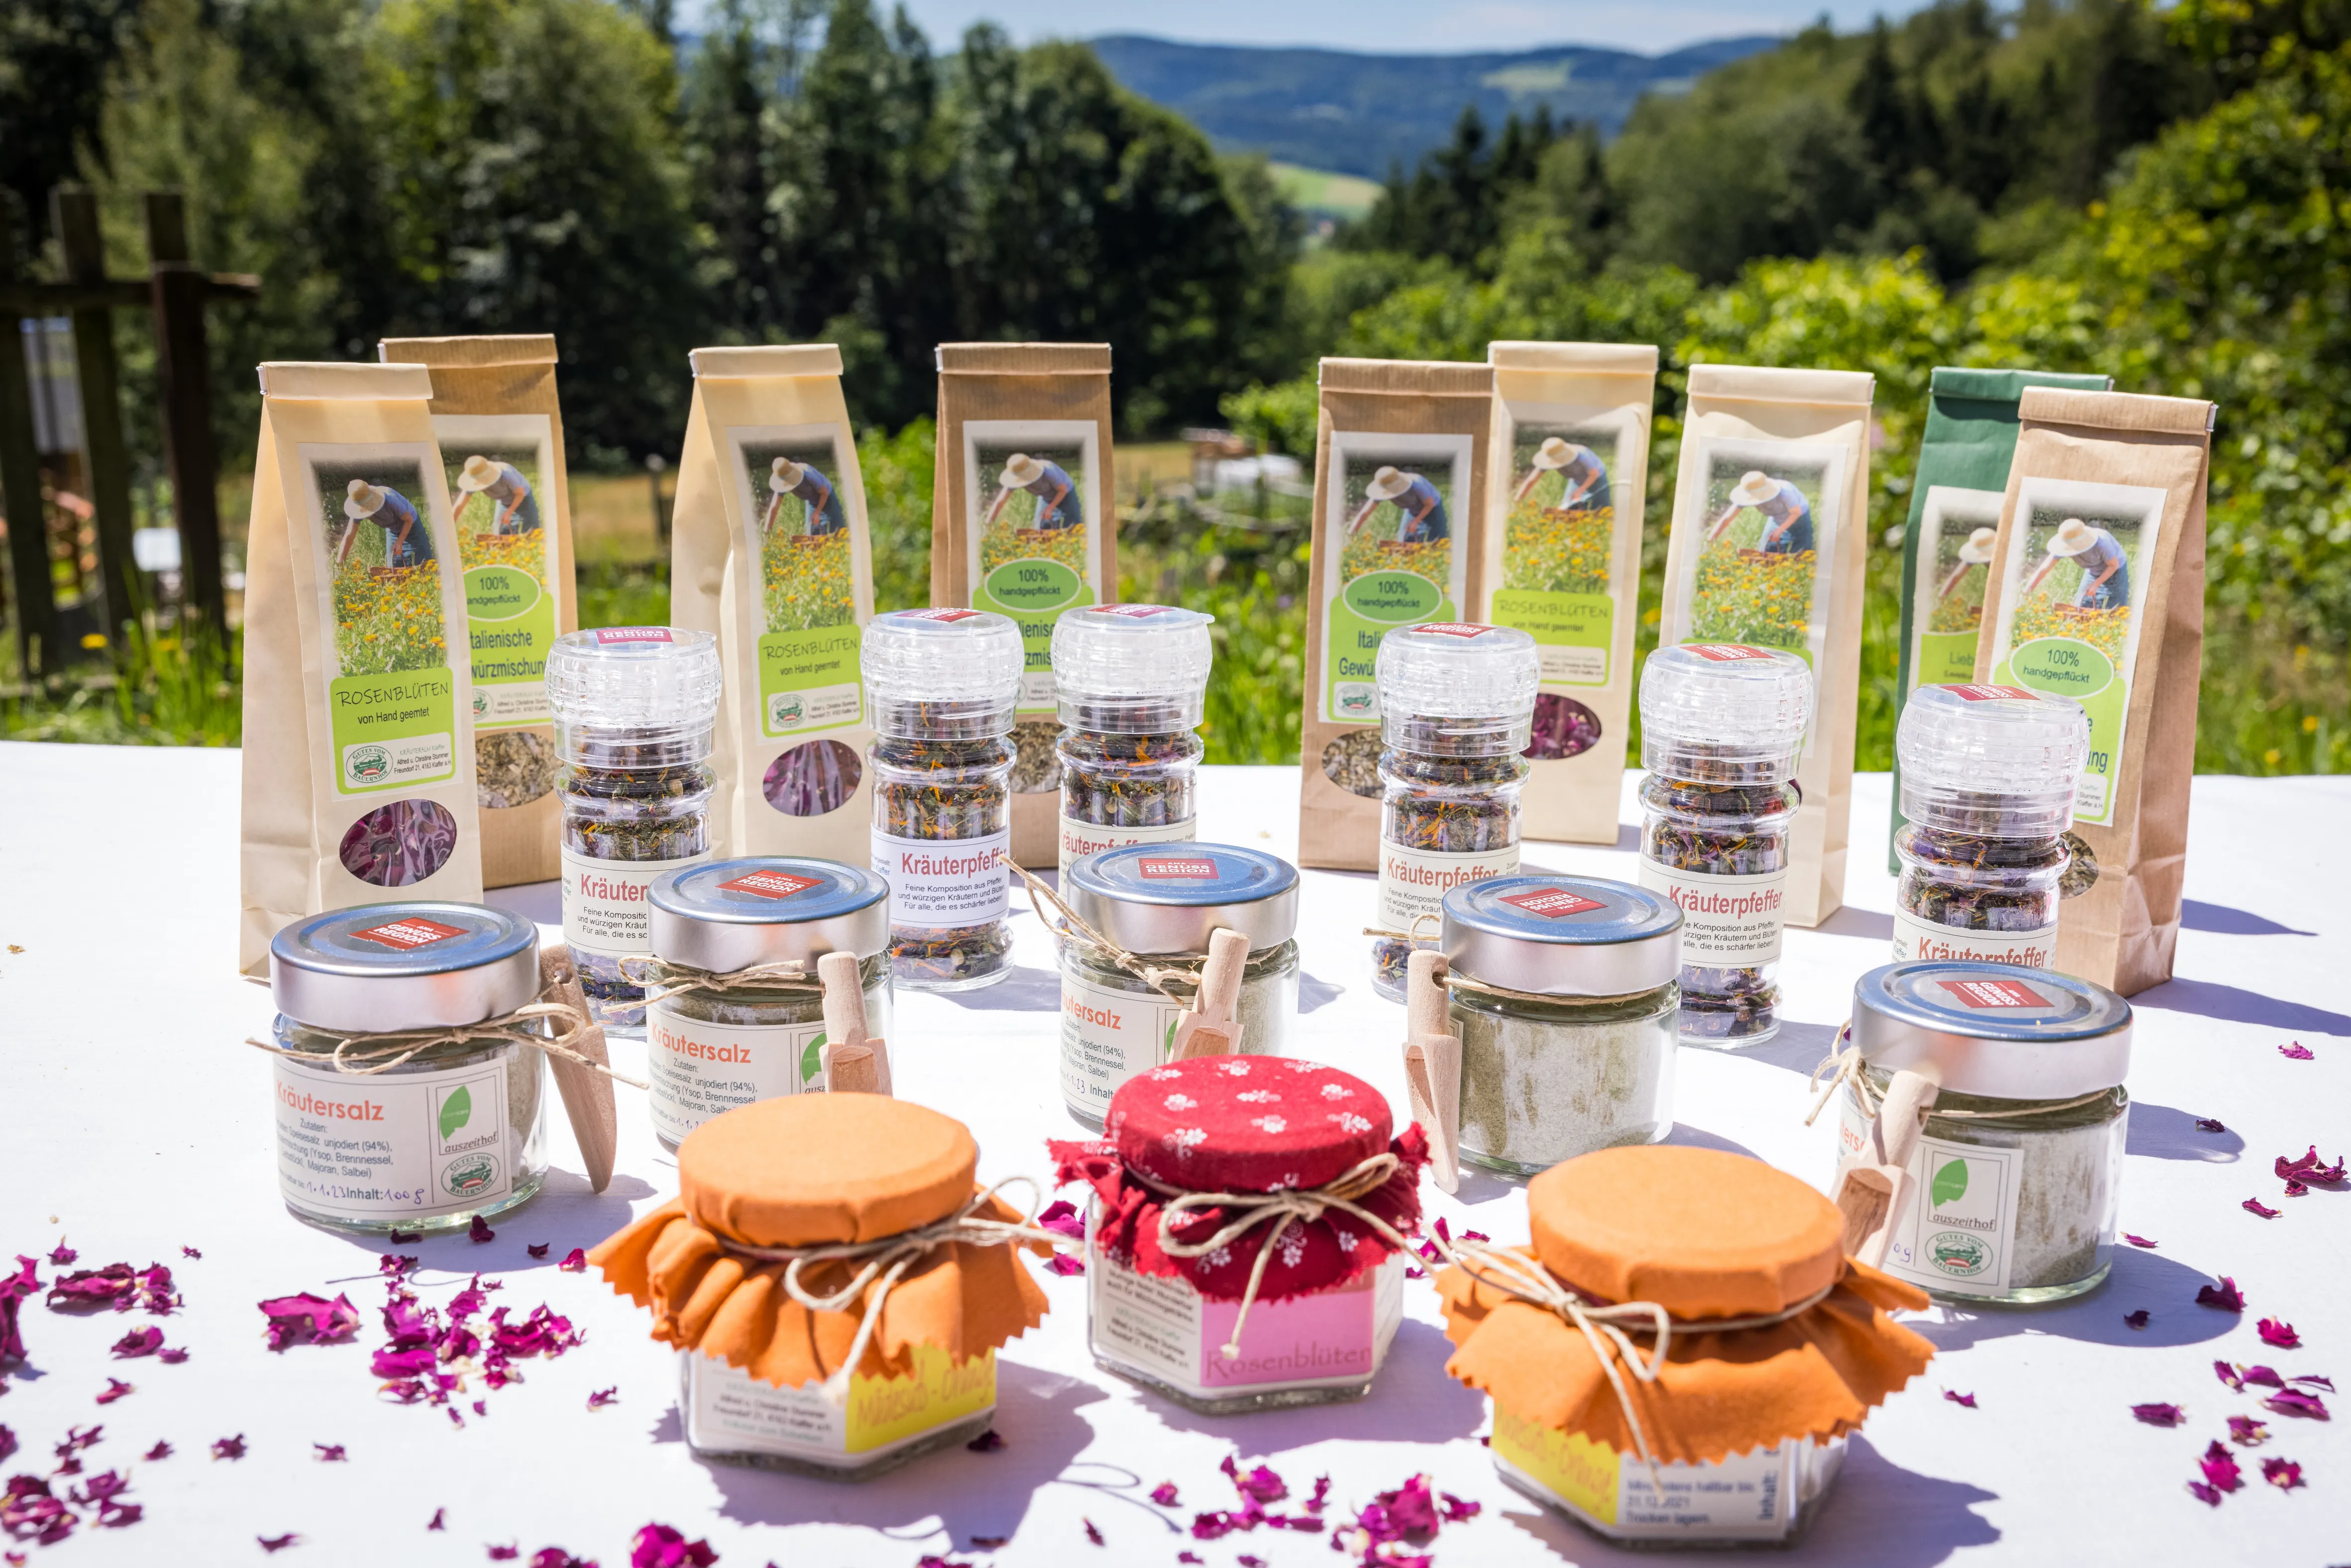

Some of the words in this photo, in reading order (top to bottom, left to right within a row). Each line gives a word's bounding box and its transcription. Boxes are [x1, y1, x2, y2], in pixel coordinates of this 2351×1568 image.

[479, 576, 510, 590] 100%
[1018, 569, 1049, 582] 100%
[1378, 581, 1409, 595] 100%
[467, 595, 521, 606] andgepflückt
[470, 628, 533, 649] talienische
[763, 637, 857, 661] ROSENBLÜTEN
[2047, 649, 2080, 667] 100%
[471, 657, 546, 679] würzmischun
[2023, 666, 2090, 684] handgepflückt
[336, 682, 448, 707] ROSENBLÜTEN
[358, 715, 374, 724] von
[376, 710, 397, 723] Hand
[400, 707, 429, 722] geerntet
[352, 748, 372, 759] GUTES
[415, 754, 431, 763] Christine
[352, 769, 388, 783] BAUERNHOF
[394, 765, 414, 774] Freundorf
[581, 873, 648, 901] Kräuter
[737, 879, 796, 892] REGION
[748, 876, 805, 889] GENUSS
[928, 884, 972, 894] Komposition
[987, 876, 1002, 887] Pfeffer
[912, 894, 945, 903] würzigen
[960, 899, 986, 909] schärfer
[987, 894, 1003, 905] lieben!
[1389, 887, 1402, 897] Feine
[1404, 892, 1441, 903] Kompositio
[1519, 893, 1573, 907] REGION
[1670, 885, 1783, 920] Kräuterpfeffer
[1392, 899, 1419, 911] würzigen
[1529, 897, 1583, 911] GENUSS
[584, 906, 602, 917] Feine
[604, 910, 647, 920] Kompositio
[1396, 908, 1408, 918] alle,
[577, 915, 588, 923] und
[590, 919, 623, 929] würzigen
[1693, 922, 1741, 932] Komposition
[1758, 921, 1775, 931] Pfeffer
[374, 927, 429, 943] REGION
[387, 924, 442, 940] GENUSS
[583, 925, 593, 934] Für
[595, 929, 610, 938] alle,
[1684, 931, 1711, 941] ürzigen
[1683, 941, 1697, 949] alle,
[1726, 942, 1756, 951] schärfer
[1757, 939, 1774, 948] lieben!
[1963, 982, 2005, 1006] REGION
[1980, 982, 2021, 1006] GENUSS
[1062, 987, 1121, 1030] äutersalz
[1066, 1016, 1081, 1033] Zutaten:
[652, 1021, 751, 1063] Kräutersalz
[1078, 1038, 1101, 1053] unjodiert
[1103, 1045, 1126, 1059] (94%),
[673, 1057, 699, 1073] Zutaten:
[1069, 1044, 1083, 1059] (Ysop,
[1084, 1051, 1126, 1071] Brennnessel,
[1068, 1055, 1086, 1073] Majoran,
[1088, 1064, 1109, 1080] Salbei)
[662, 1064, 691, 1084] Speisesalz
[695, 1078, 728, 1091] unjodiert
[730, 1081, 757, 1093] (94%),
[277, 1079, 384, 1121] Kräutersalz
[682, 1085, 703, 1100] (Ysop,
[706, 1091, 755, 1104] Brennnessel
[1090, 1084, 1114, 1100] Inhalt
[679, 1096, 708, 1113] Majoran,
[300, 1118, 327, 1133] Zutaten:
[289, 1126, 320, 1145] Speisesalz
[324, 1138, 359, 1151] unjodiert
[444, 1131, 498, 1153] auszeithof
[310, 1148, 333, 1161] (Ysop,
[336, 1152, 393, 1165] Brennnessel,
[450, 1155, 474, 1171] GUTES
[476, 1154, 491, 1163] VOM
[308, 1159, 339, 1175] Majoran,
[342, 1166, 372, 1179] Salbei)
[346, 1187, 383, 1200] Inhalt:
[449, 1177, 493, 1195] BAUERNHOF
[1933, 1214, 1996, 1229] auszeithof
[1967, 1237, 1984, 1249] VOM
[1932, 1257, 1981, 1274] BAUERNHOF
